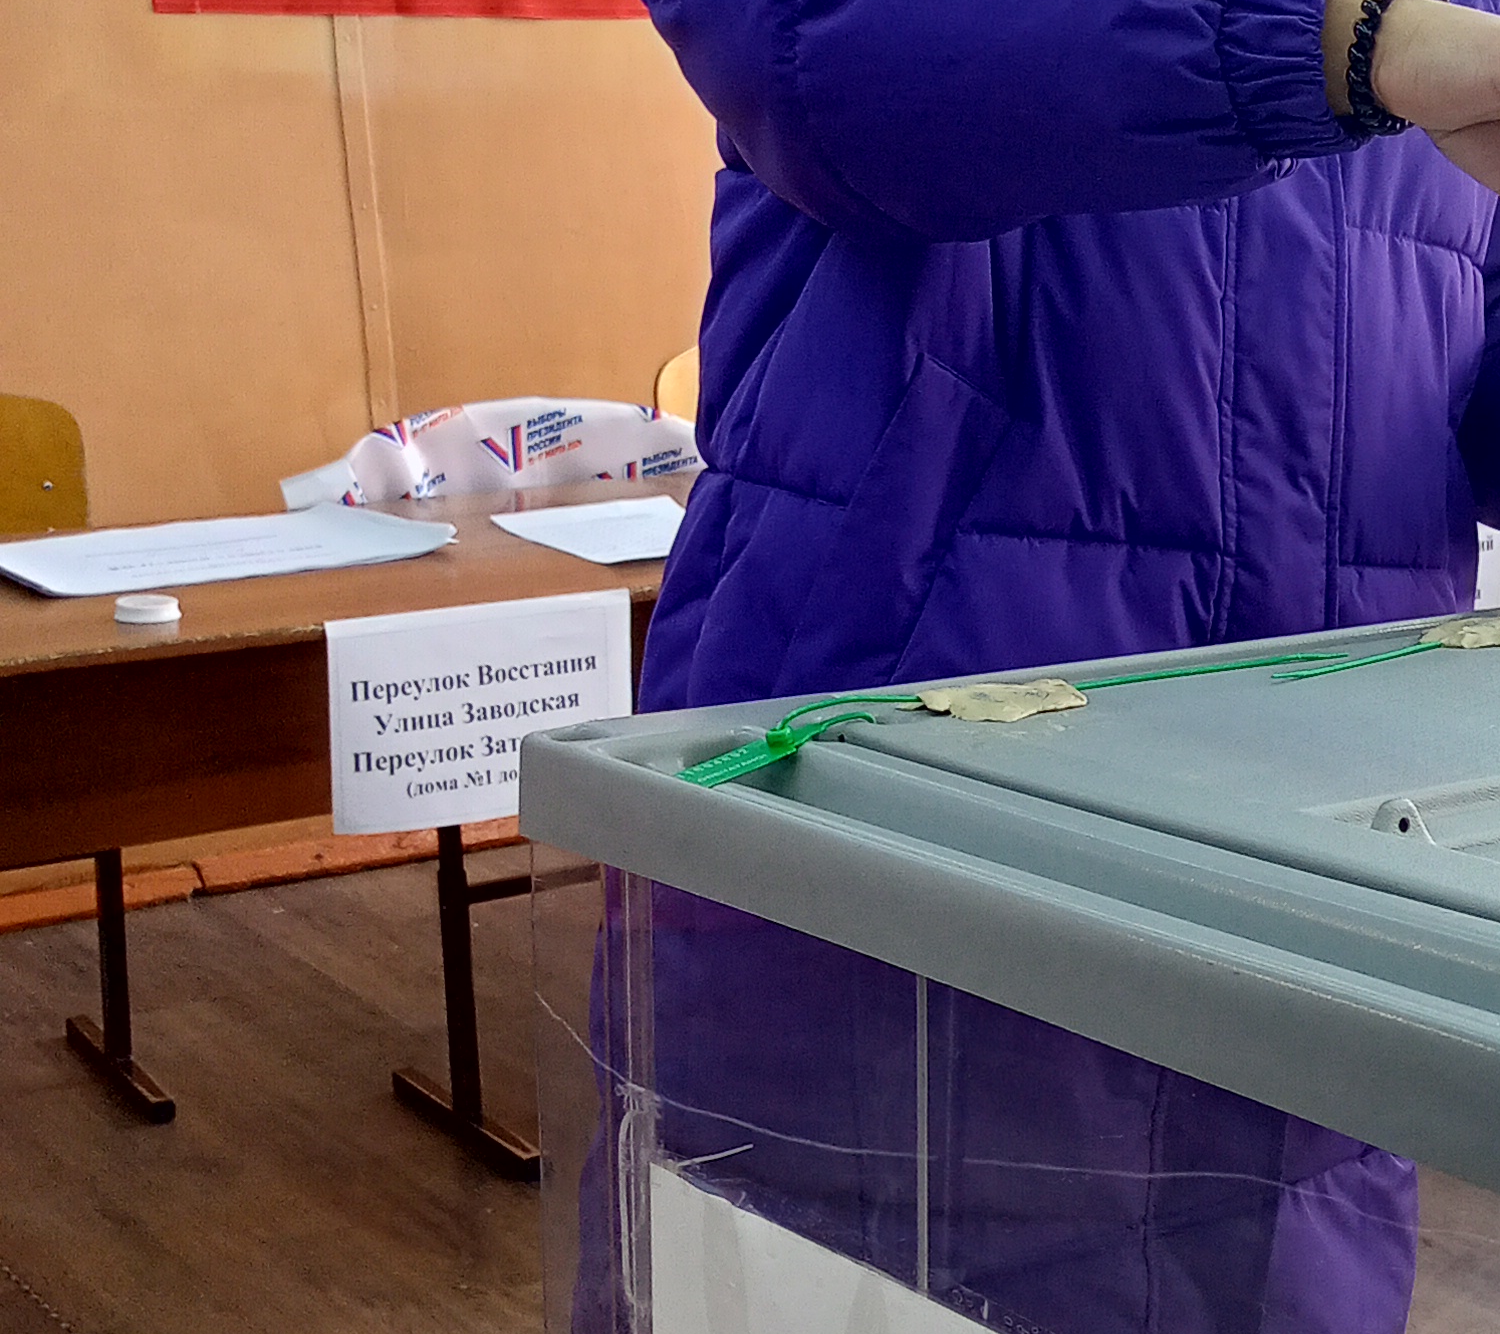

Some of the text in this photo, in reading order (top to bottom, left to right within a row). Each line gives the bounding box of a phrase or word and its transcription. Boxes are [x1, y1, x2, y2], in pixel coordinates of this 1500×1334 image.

[527, 408, 566, 428] ВЫБОРЫ
[527, 415, 583, 441] ПРЕЗИДЕНТА
[528, 434, 561, 454] РОССИИ
[642, 448, 682, 466] ВЫБОРЫ
[351, 655, 597, 704] Переулок Восстания
[374, 692, 580, 736] Улица Заводская
[353, 742, 474, 776] Переулок
[407, 779, 458, 798] (дома
[464, 769, 491, 788] №1
